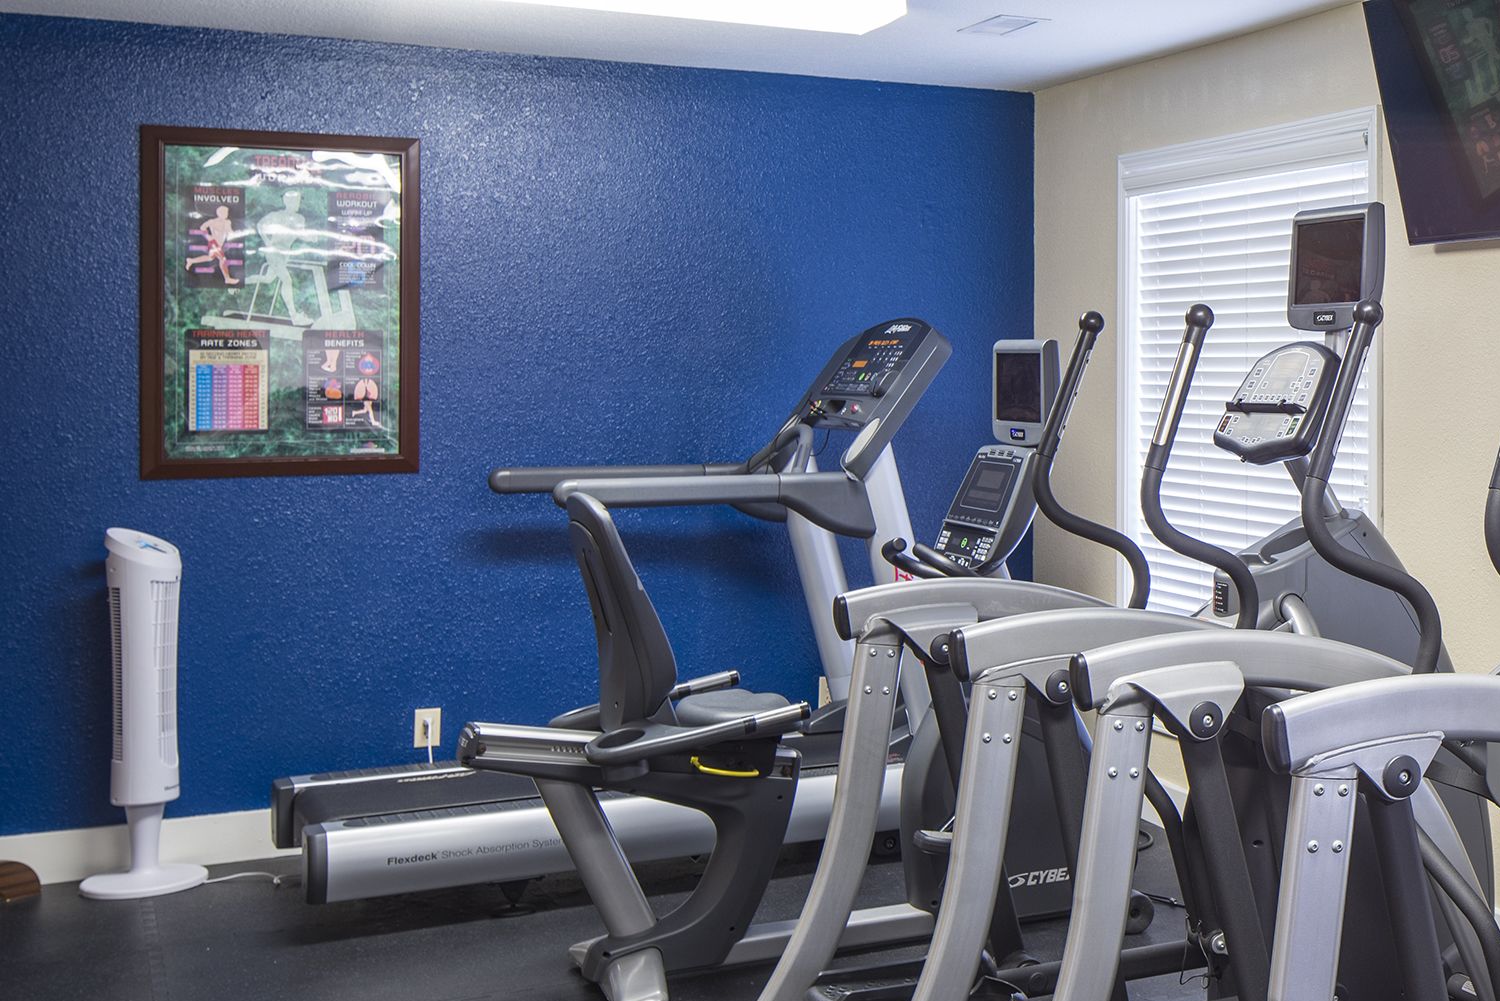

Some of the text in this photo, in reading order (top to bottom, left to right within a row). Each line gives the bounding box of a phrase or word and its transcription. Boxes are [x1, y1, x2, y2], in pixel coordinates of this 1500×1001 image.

[193, 194, 240, 203] INVOLVED
[336, 200, 377, 208] WORKOUT
[324, 331, 365, 339] HEALTH
[200, 339, 258, 347] RATE ZONES
[324, 339, 365, 347] BENEFITS
[387, 852, 438, 866] Flexdeck
[441, 847, 473, 860] Shock
[476, 841, 530, 855] Absorption
